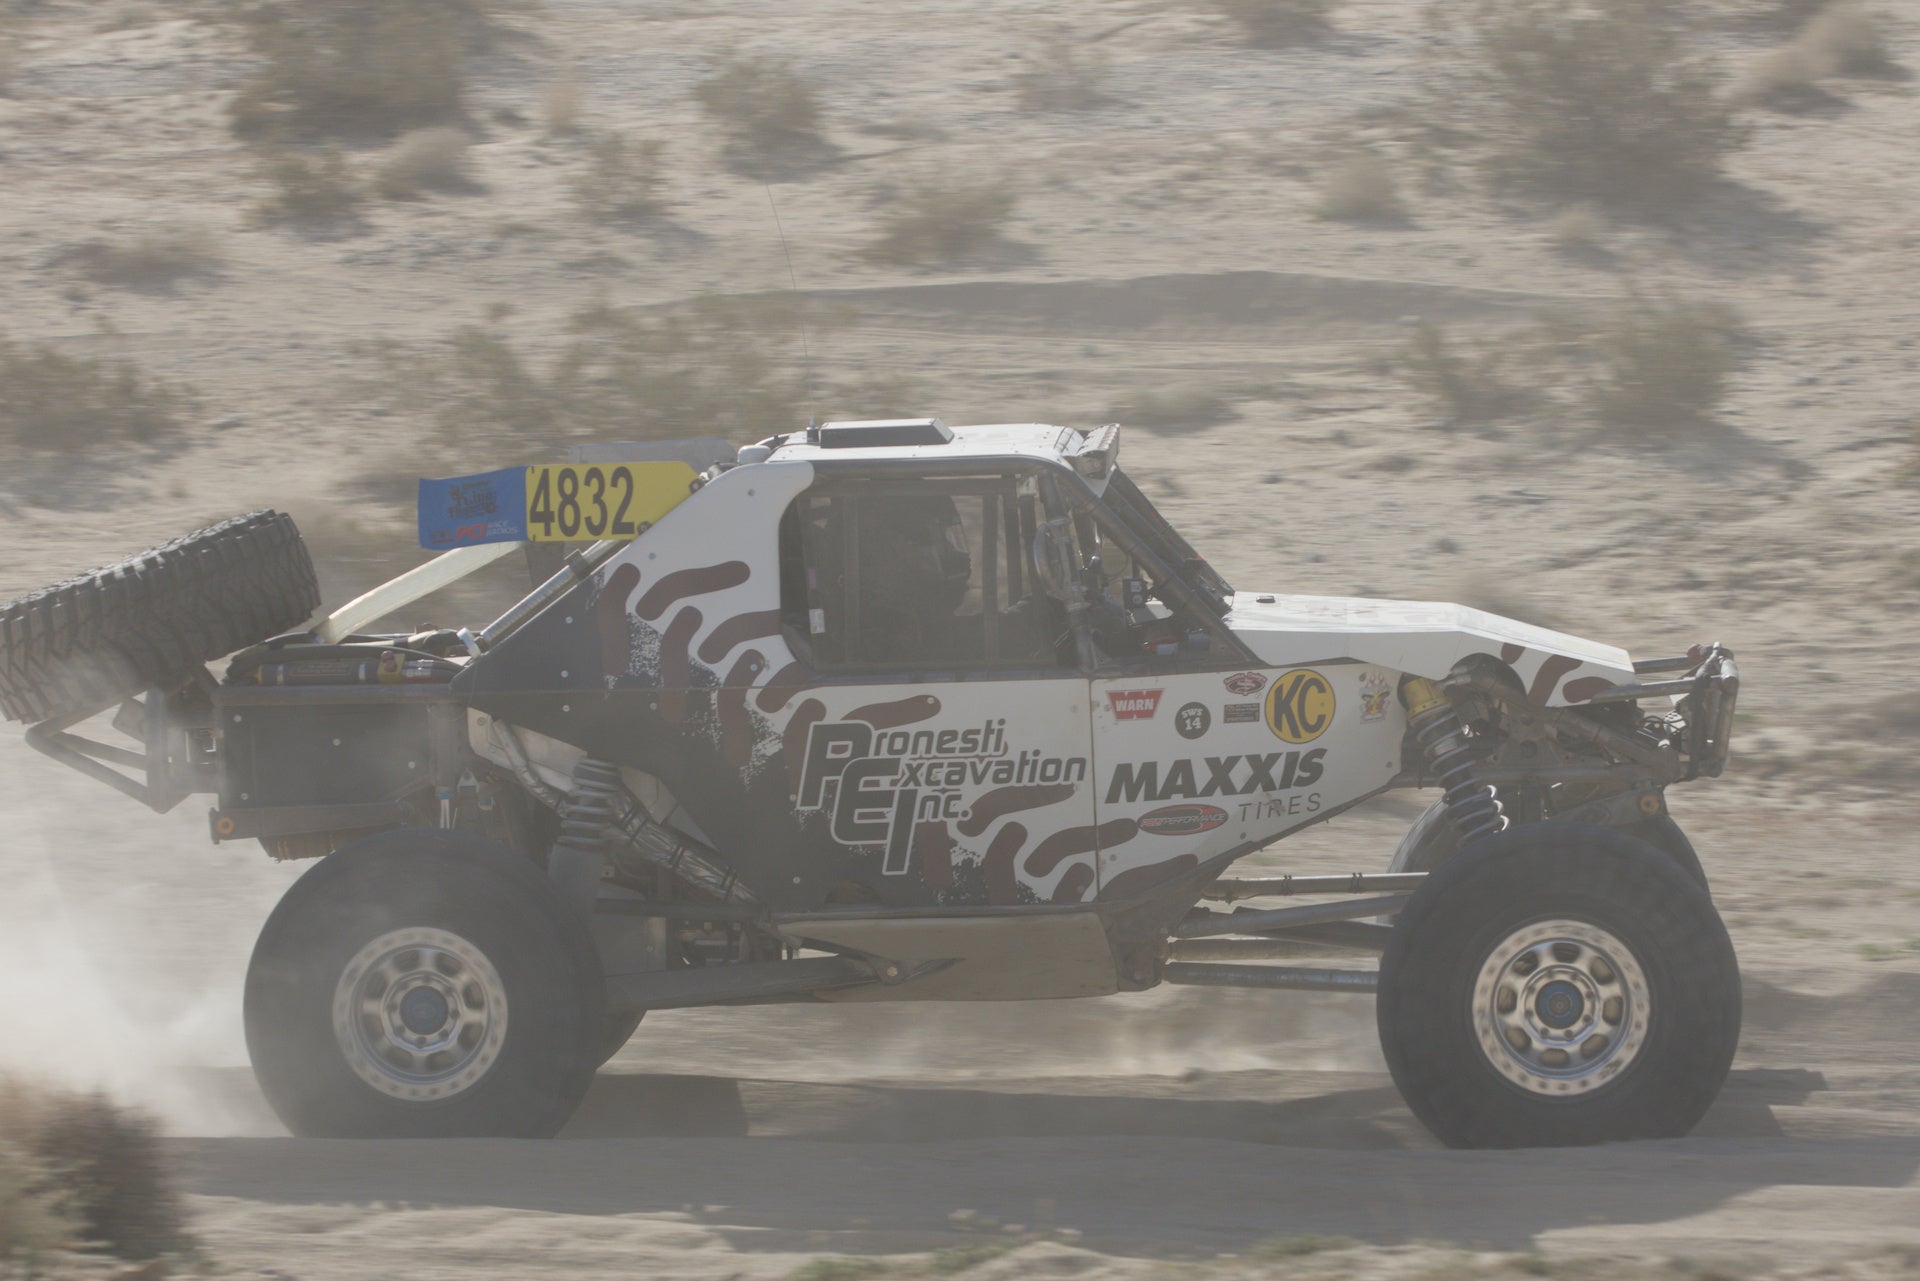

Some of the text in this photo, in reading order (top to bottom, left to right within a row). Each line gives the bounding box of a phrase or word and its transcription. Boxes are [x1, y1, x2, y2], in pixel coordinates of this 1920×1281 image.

[456, 523, 488, 541] PCI
[529, 466, 635, 537] 4832
[1114, 698, 1154, 713] WARN
[1185, 717, 1202, 731] 14
[1273, 674, 1327, 739] KC
[795, 718, 1008, 810] Pronesti
[1104, 747, 1329, 805] MAXXIS
[829, 748, 1088, 846] Excavation
[1237, 792, 1322, 823] TIRES
[881, 787, 973, 876] Inc.
